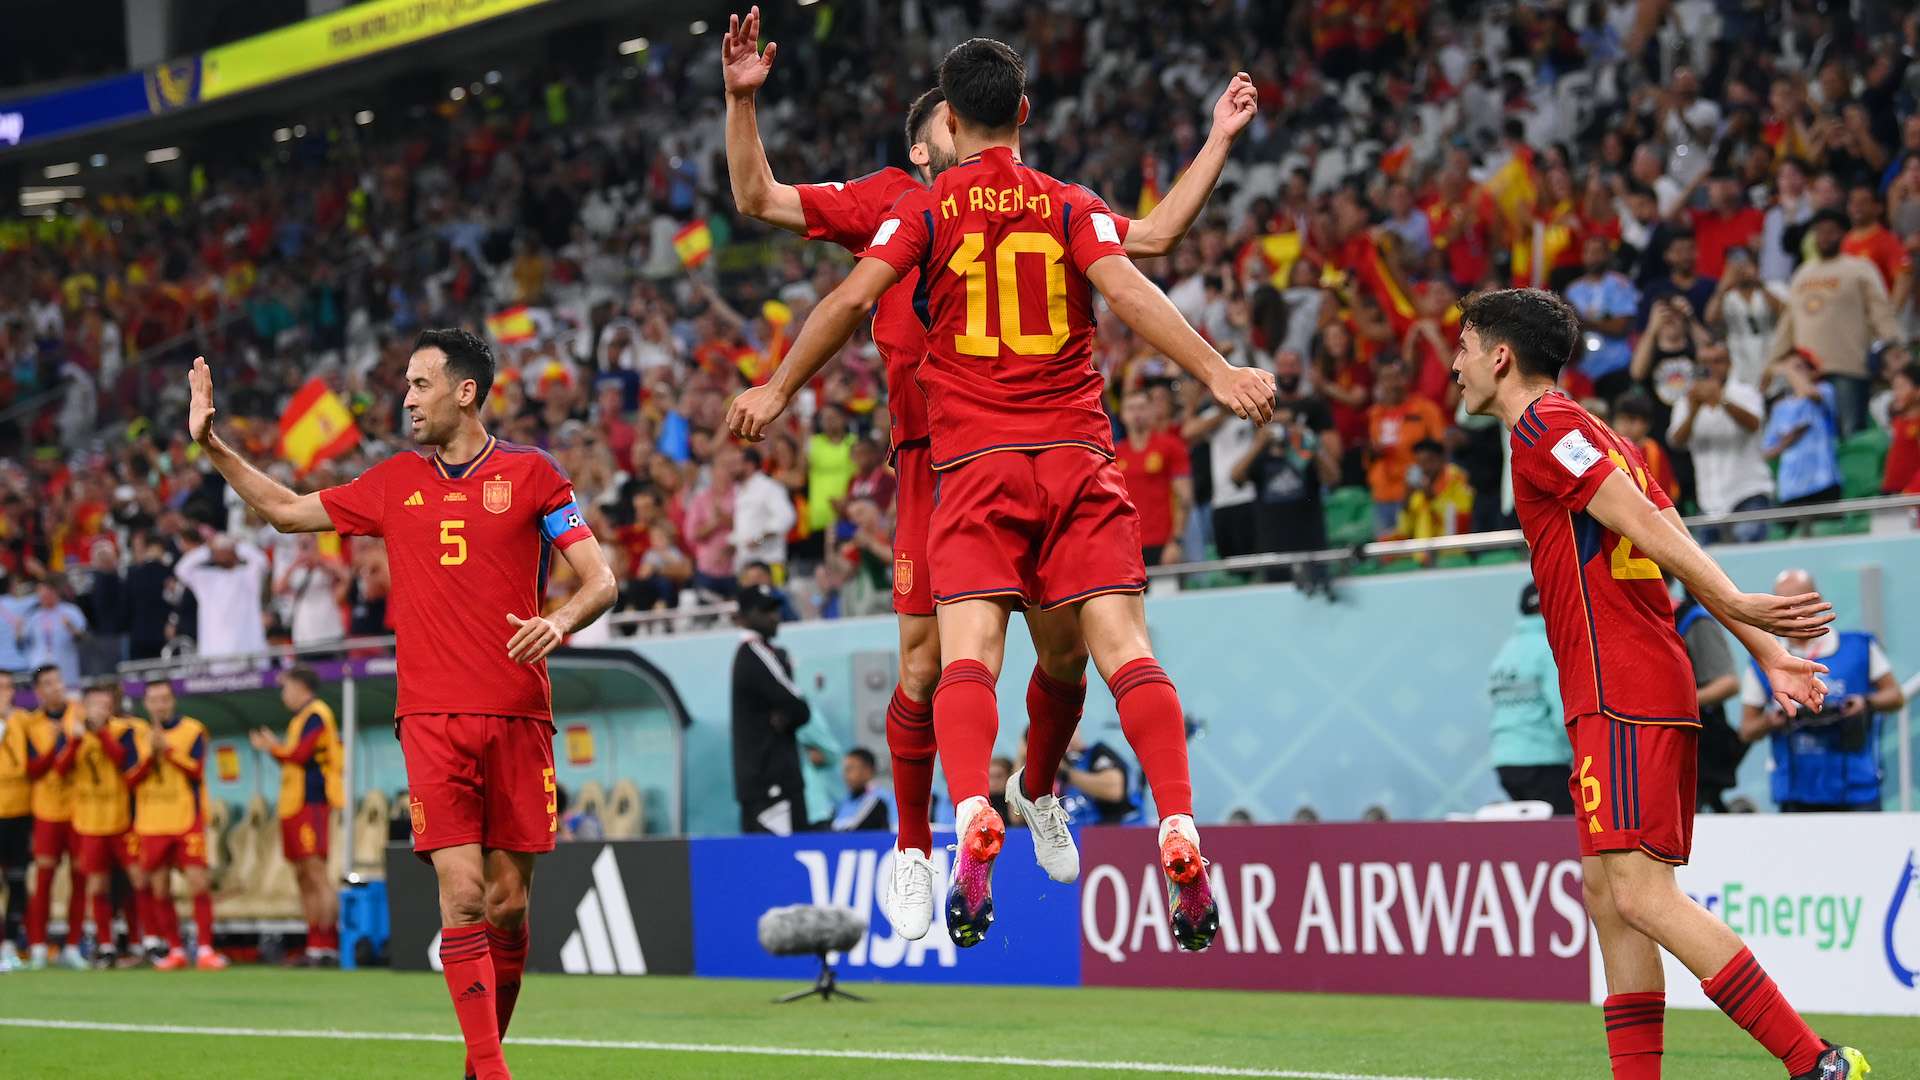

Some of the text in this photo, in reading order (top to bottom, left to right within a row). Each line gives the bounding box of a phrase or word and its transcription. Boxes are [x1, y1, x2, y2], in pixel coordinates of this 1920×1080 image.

[941, 193, 959, 220] M
[947, 232, 1070, 356] 10
[440, 520, 467, 566] 5
[543, 767, 557, 814] 5
[1580, 755, 1602, 813] 6
[794, 848, 958, 968] VISA
[1082, 859, 1588, 962] QAAR AIRWAYS
